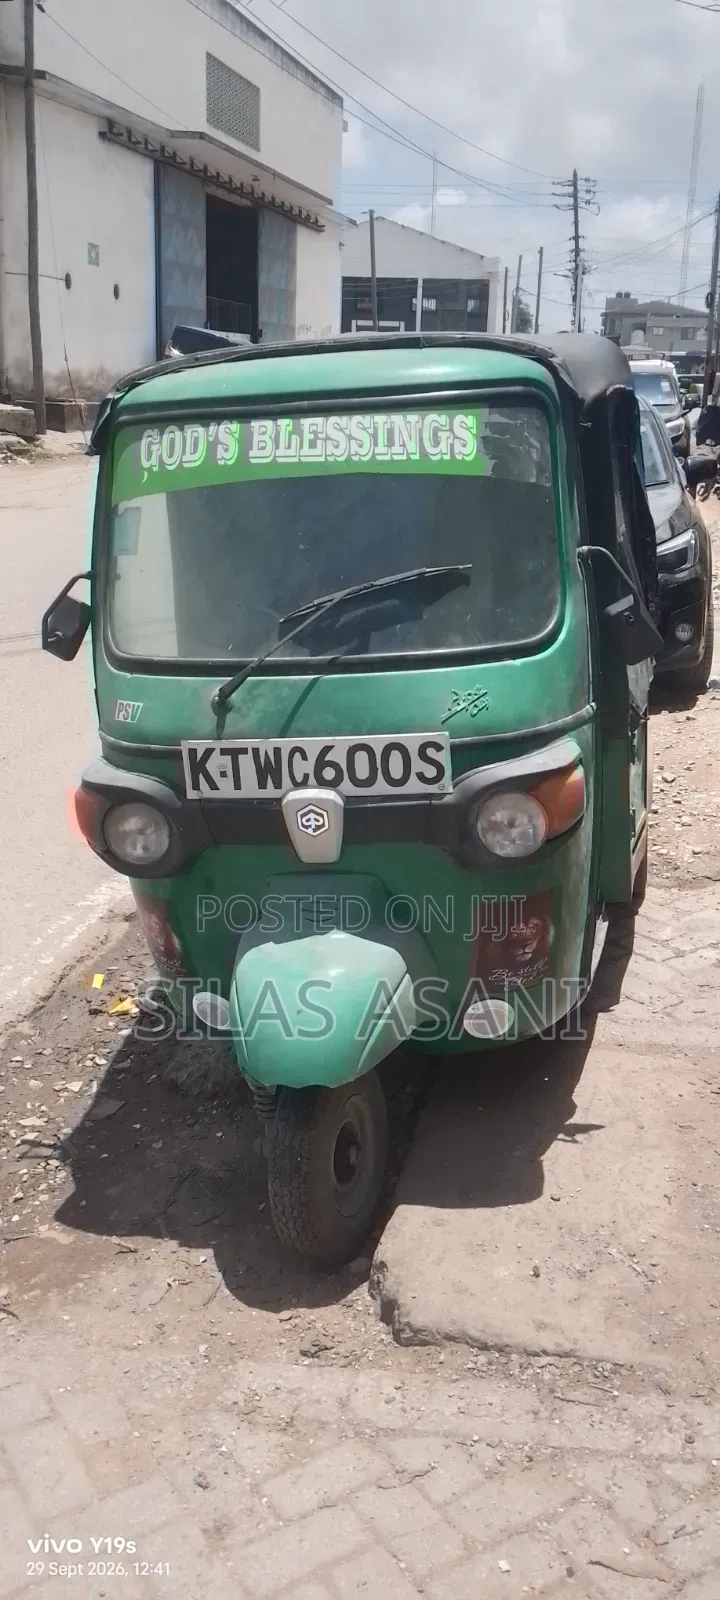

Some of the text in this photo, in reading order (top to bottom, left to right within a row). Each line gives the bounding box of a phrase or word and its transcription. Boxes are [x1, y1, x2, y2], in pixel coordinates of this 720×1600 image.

[140, 413, 477, 472] GOD'S BLESSINGS
[116, 701, 142, 722] PSV
